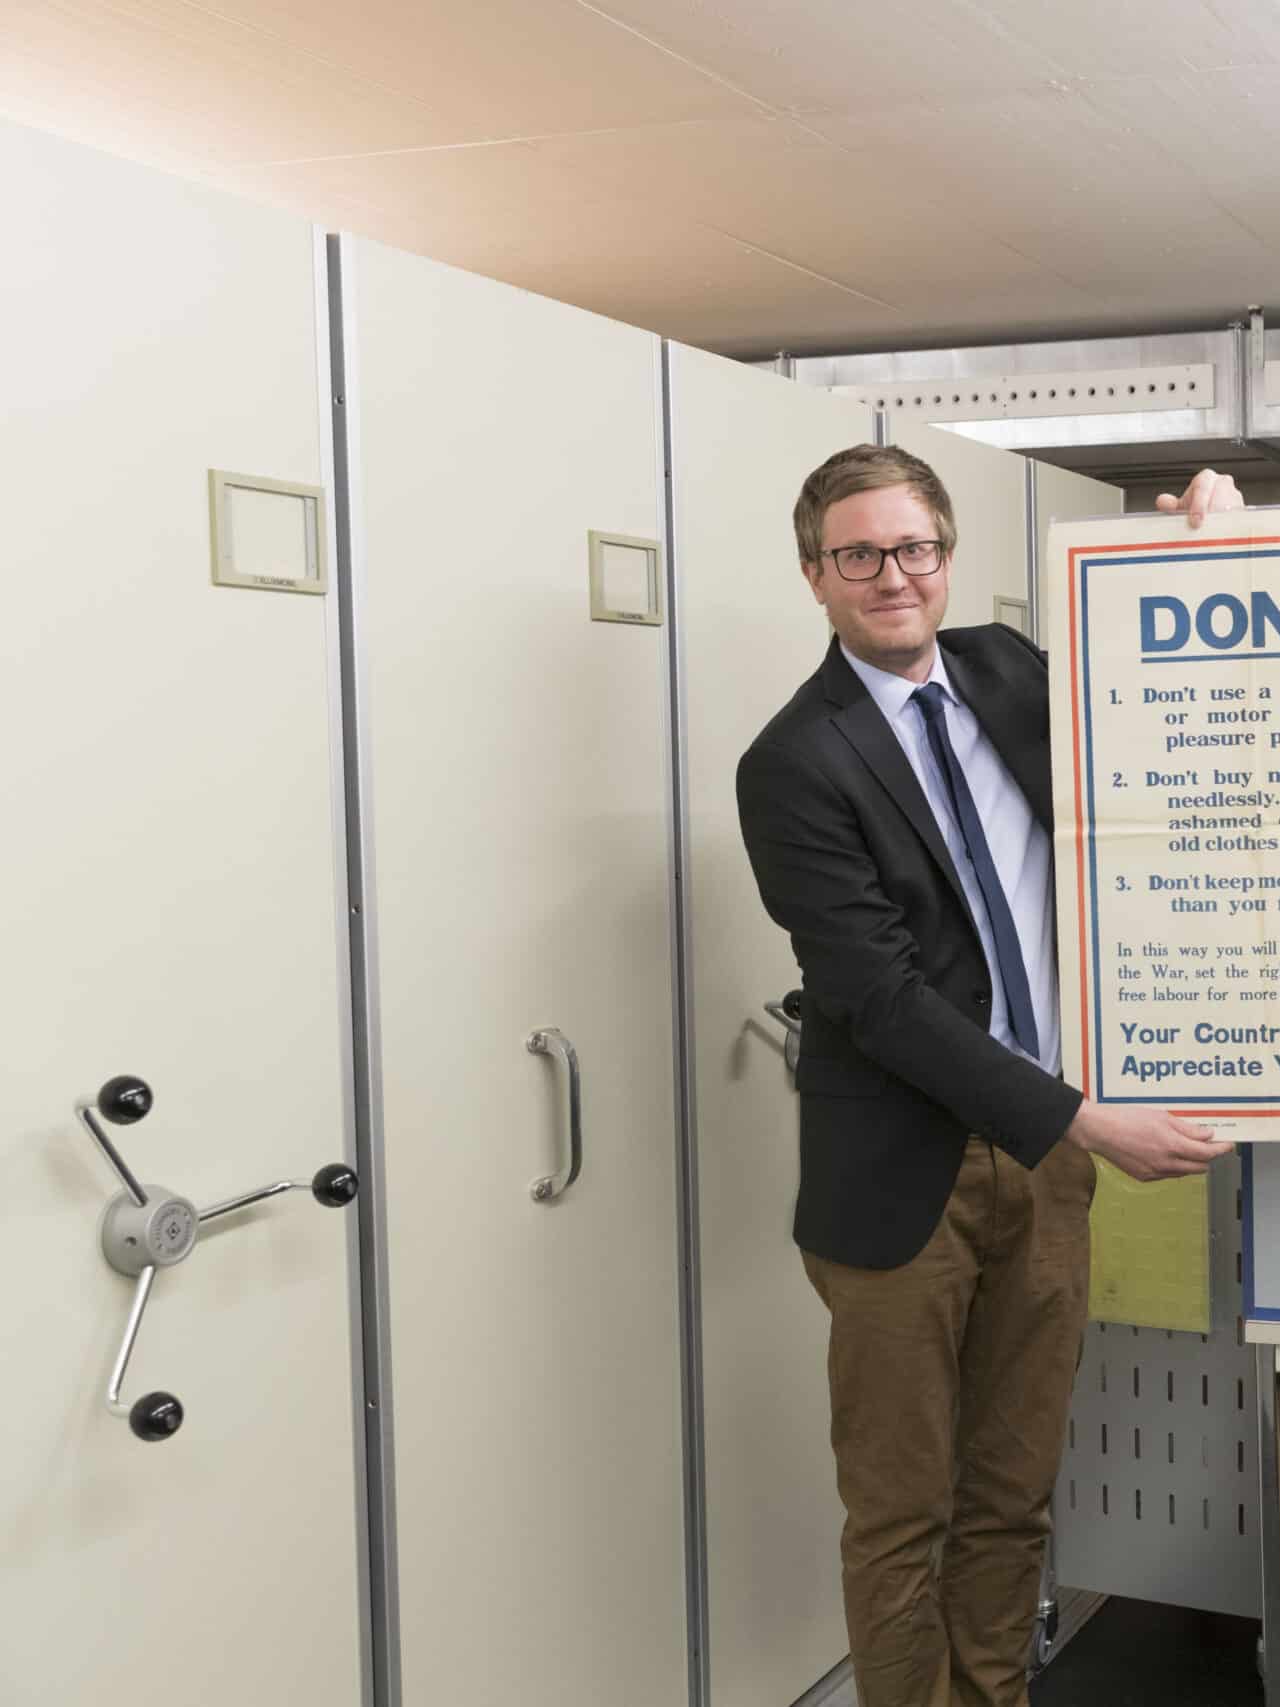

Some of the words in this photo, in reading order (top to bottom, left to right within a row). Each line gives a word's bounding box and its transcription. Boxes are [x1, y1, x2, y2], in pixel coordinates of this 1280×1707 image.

[1109, 688, 1123, 705] 1.
[1143, 686, 1197, 704] Don't
[1209, 687, 1247, 702] use
[1258, 687, 1272, 700] a
[1164, 712, 1189, 726] or
[1207, 707, 1273, 725] motor
[1165, 731, 1256, 753] pleasure
[1112, 771, 1129, 789] 2.
[1145, 770, 1199, 787] Don't
[1213, 768, 1253, 789] buy
[1167, 790, 1280, 809] needlessly.
[1168, 812, 1263, 830] ashamed
[1168, 835, 1201, 852] old
[1204, 834, 1279, 852] clothes
[1115, 875, 1132, 892] 3.
[1148, 874, 1201, 891] Don't
[1204, 873, 1256, 894] keep
[1170, 896, 1218, 913] than
[1228, 898, 1267, 917] you
[1116, 941, 1133, 958] In
[1142, 941, 1169, 958] this
[1178, 946, 1209, 960] way
[1215, 945, 1244, 960] you
[1251, 939, 1278, 956] will
[1117, 963, 1142, 980] the
[1151, 963, 1189, 982] War,
[1194, 967, 1216, 980] set
[1225, 962, 1249, 979] the
[1117, 986, 1147, 1002] free
[1153, 985, 1201, 1002] labour
[1207, 985, 1230, 1001] for
[1239, 990, 1278, 1001] more
[1119, 1022, 1181, 1045] Your
[1120, 1054, 1264, 1083] Appreciate
